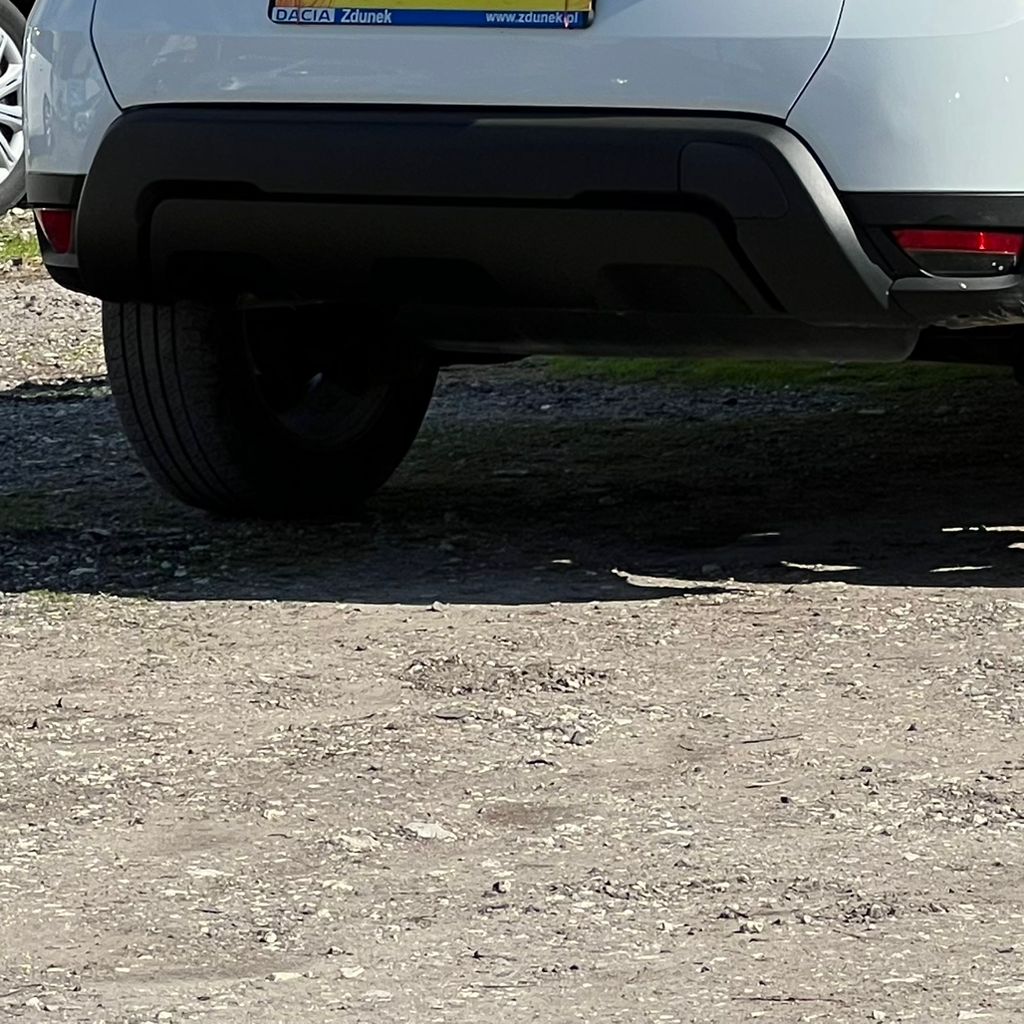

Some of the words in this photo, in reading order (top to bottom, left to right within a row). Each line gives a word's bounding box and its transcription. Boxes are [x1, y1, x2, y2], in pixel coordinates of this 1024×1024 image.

[276, 9, 331, 21] DACIA
[341, 8, 392, 24] Zdunek
[486, 11, 578, 24] www.zdunek.pl
